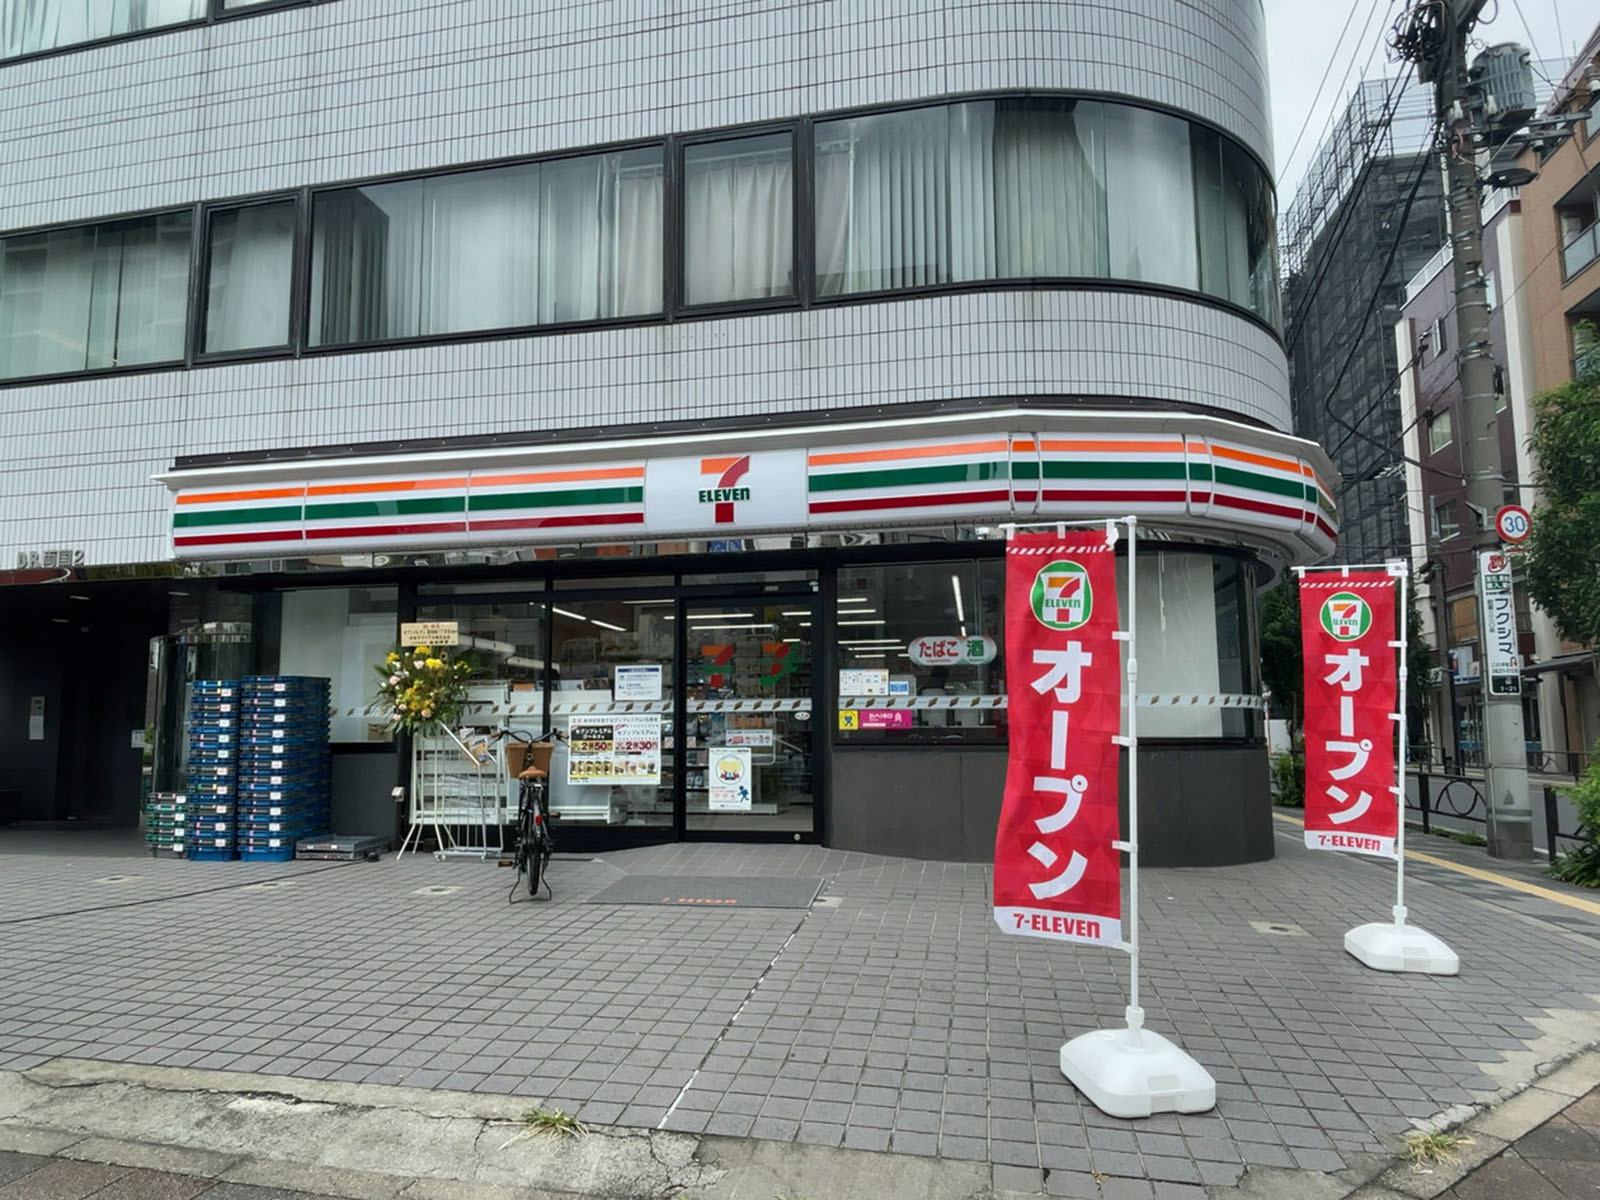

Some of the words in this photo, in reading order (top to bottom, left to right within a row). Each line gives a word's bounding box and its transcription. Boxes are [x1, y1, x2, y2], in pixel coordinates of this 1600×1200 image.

[1504, 515, 1526, 533] 30
[919, 640, 959, 658] たばこ
[967, 640, 985, 657] 酒
[1495, 598, 1513, 655] フクシマ
[1323, 648, 1373, 825] オープン
[1027, 640, 1092, 900] オープン
